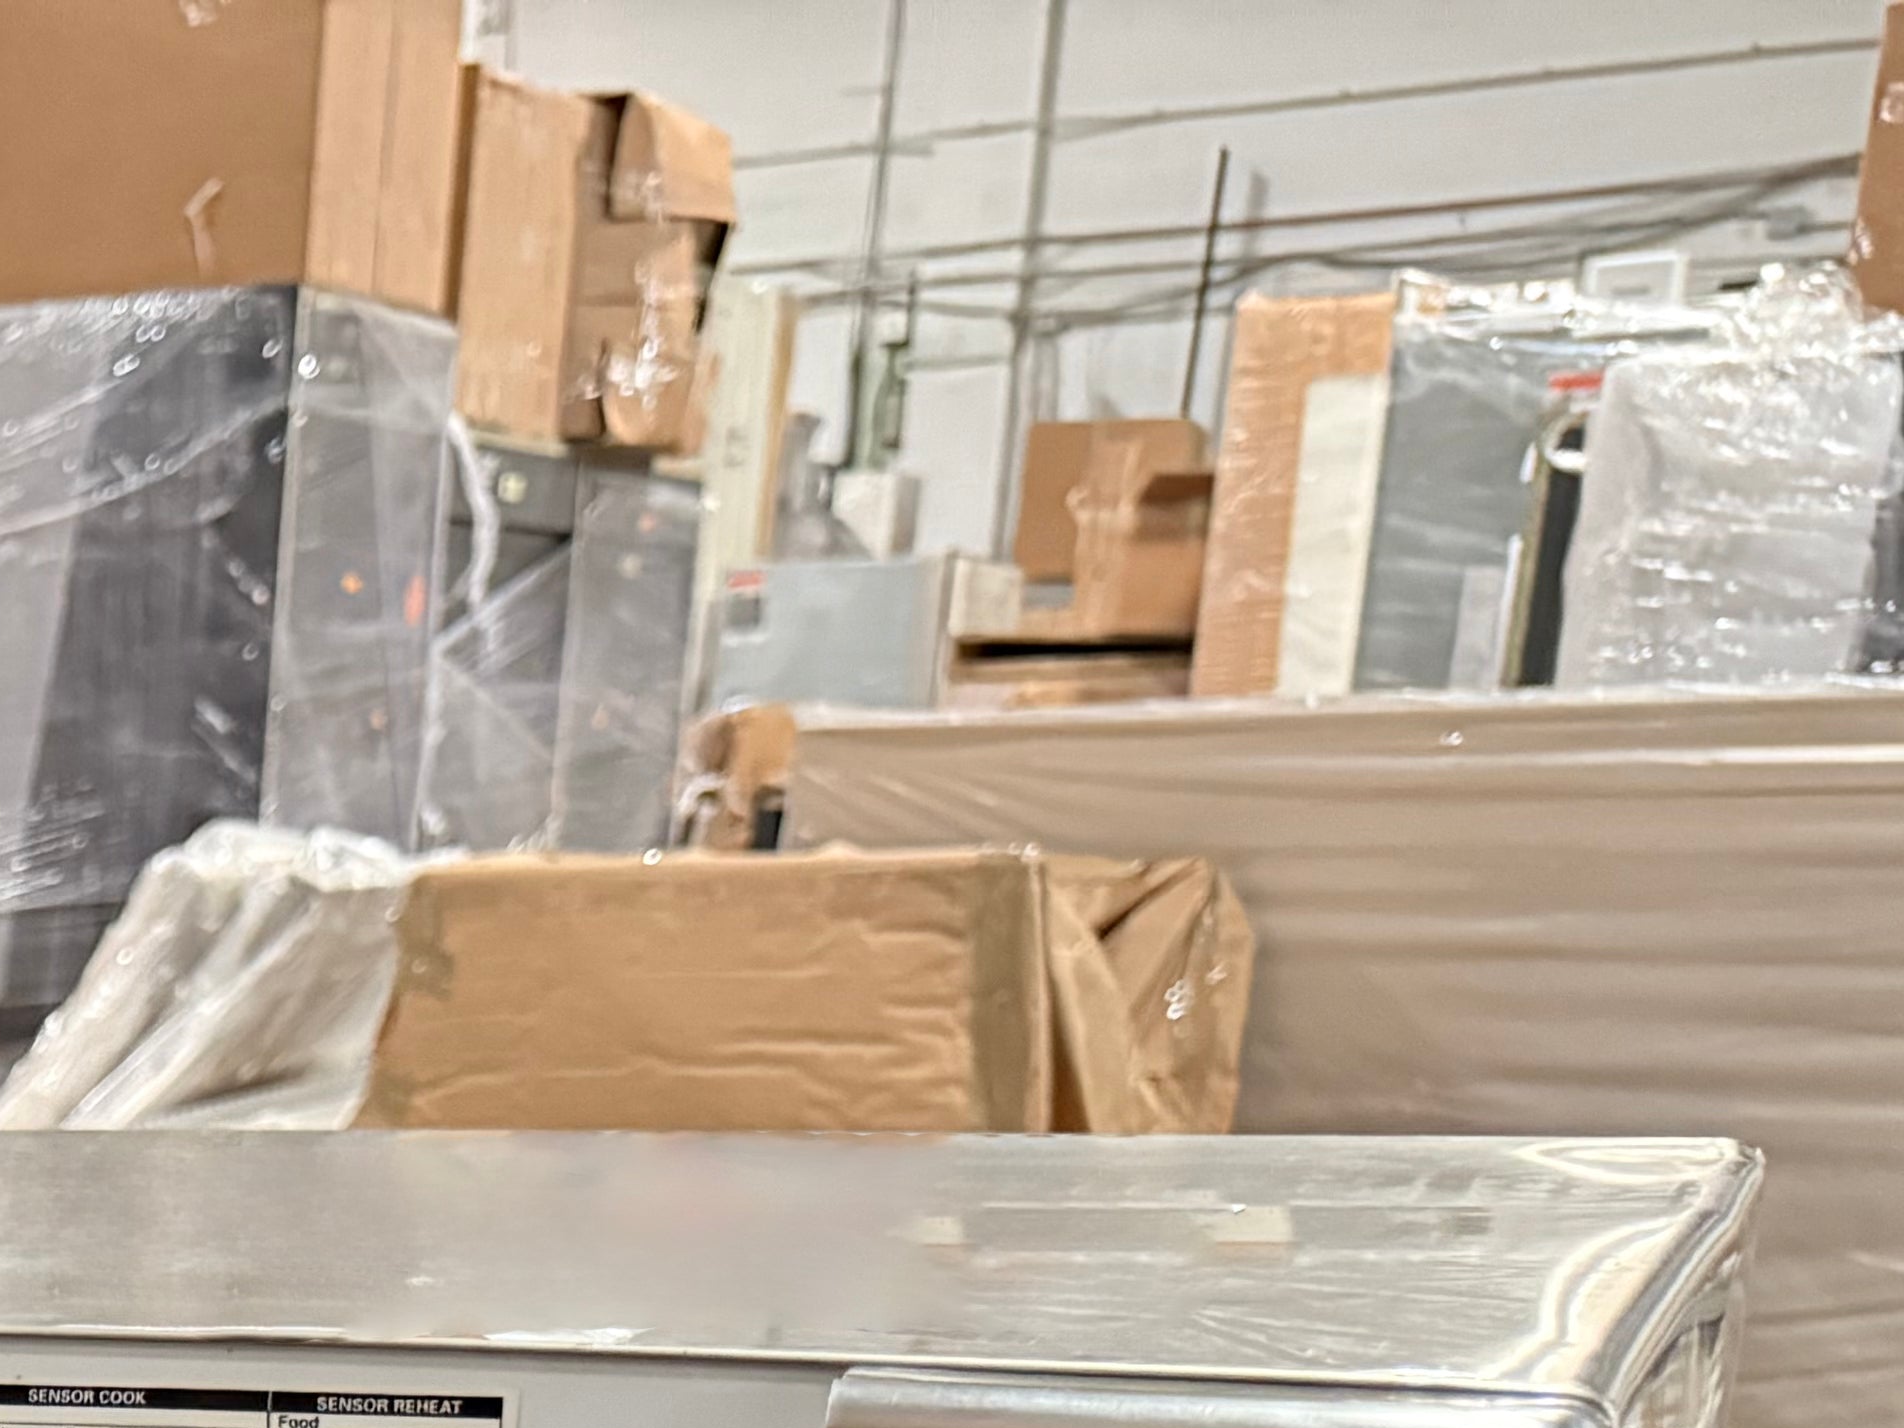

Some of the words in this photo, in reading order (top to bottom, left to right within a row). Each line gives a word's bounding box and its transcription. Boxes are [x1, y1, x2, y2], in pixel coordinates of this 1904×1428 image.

[28, 1388, 94, 1405] SENSOR
[99, 1390, 147, 1406] COOK
[316, 1396, 389, 1413] SENSOR
[393, 1399, 463, 1415] REHEAT
